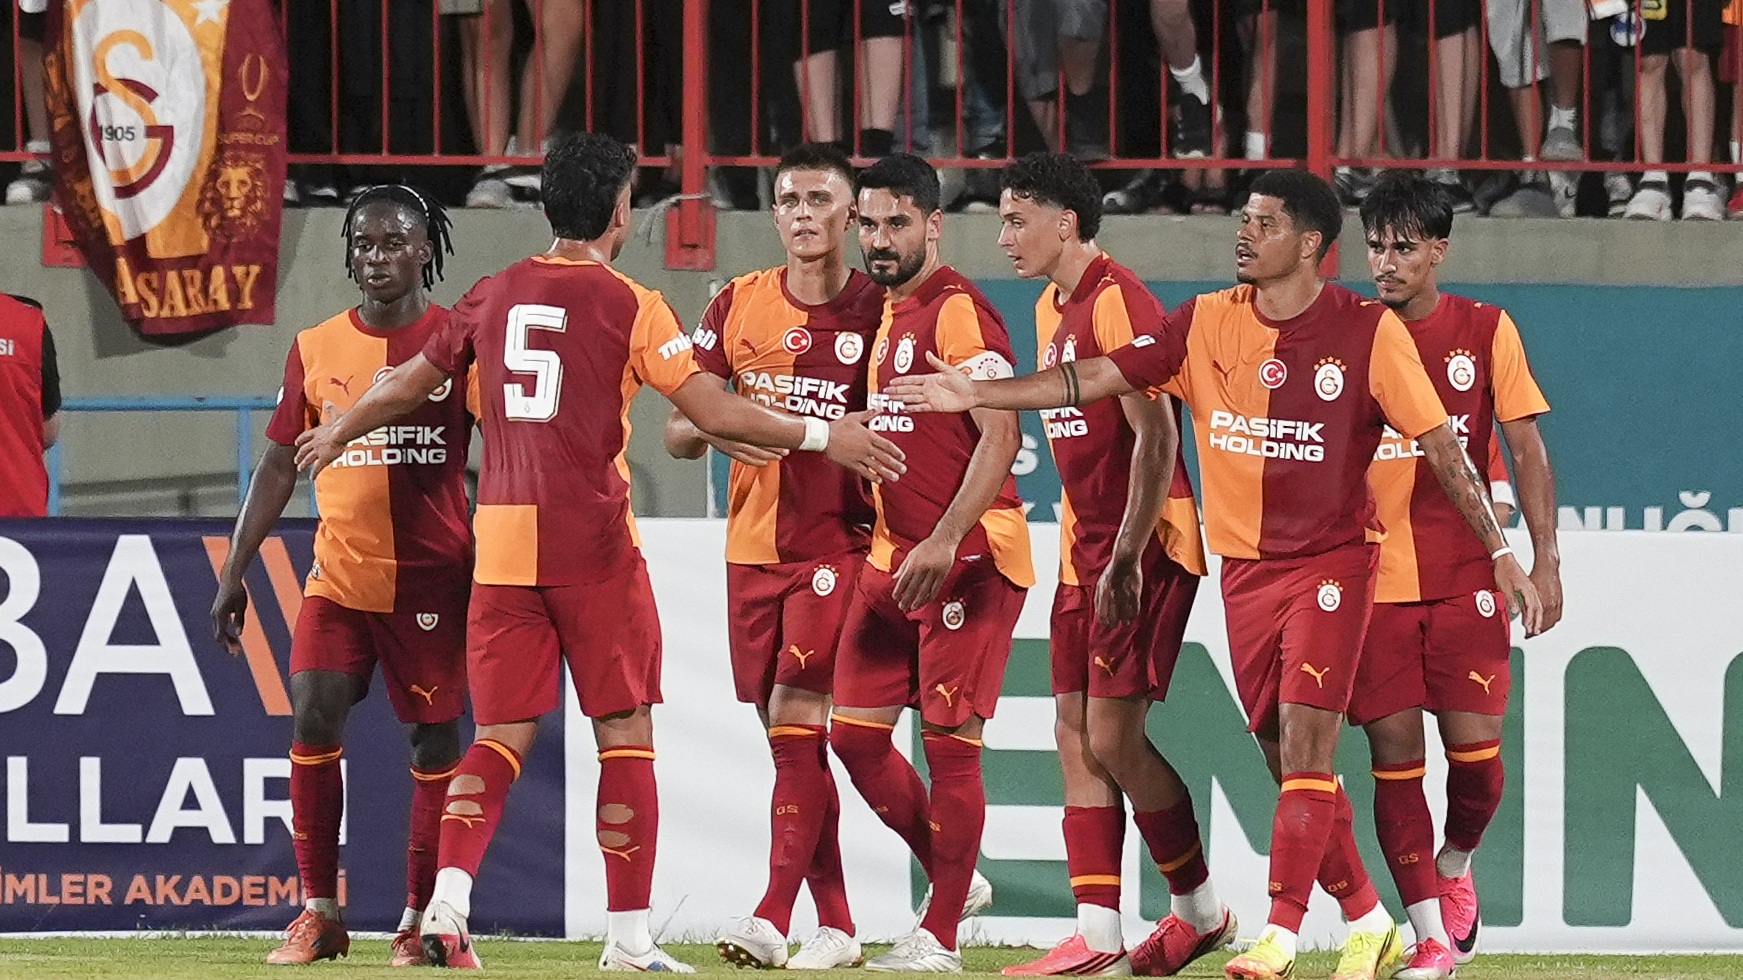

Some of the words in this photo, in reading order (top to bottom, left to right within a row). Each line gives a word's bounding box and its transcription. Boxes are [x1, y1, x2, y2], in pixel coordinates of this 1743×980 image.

[101, 125, 136, 142] 1905
[503, 303, 568, 423] 5
[0, 867, 113, 905] MLER
